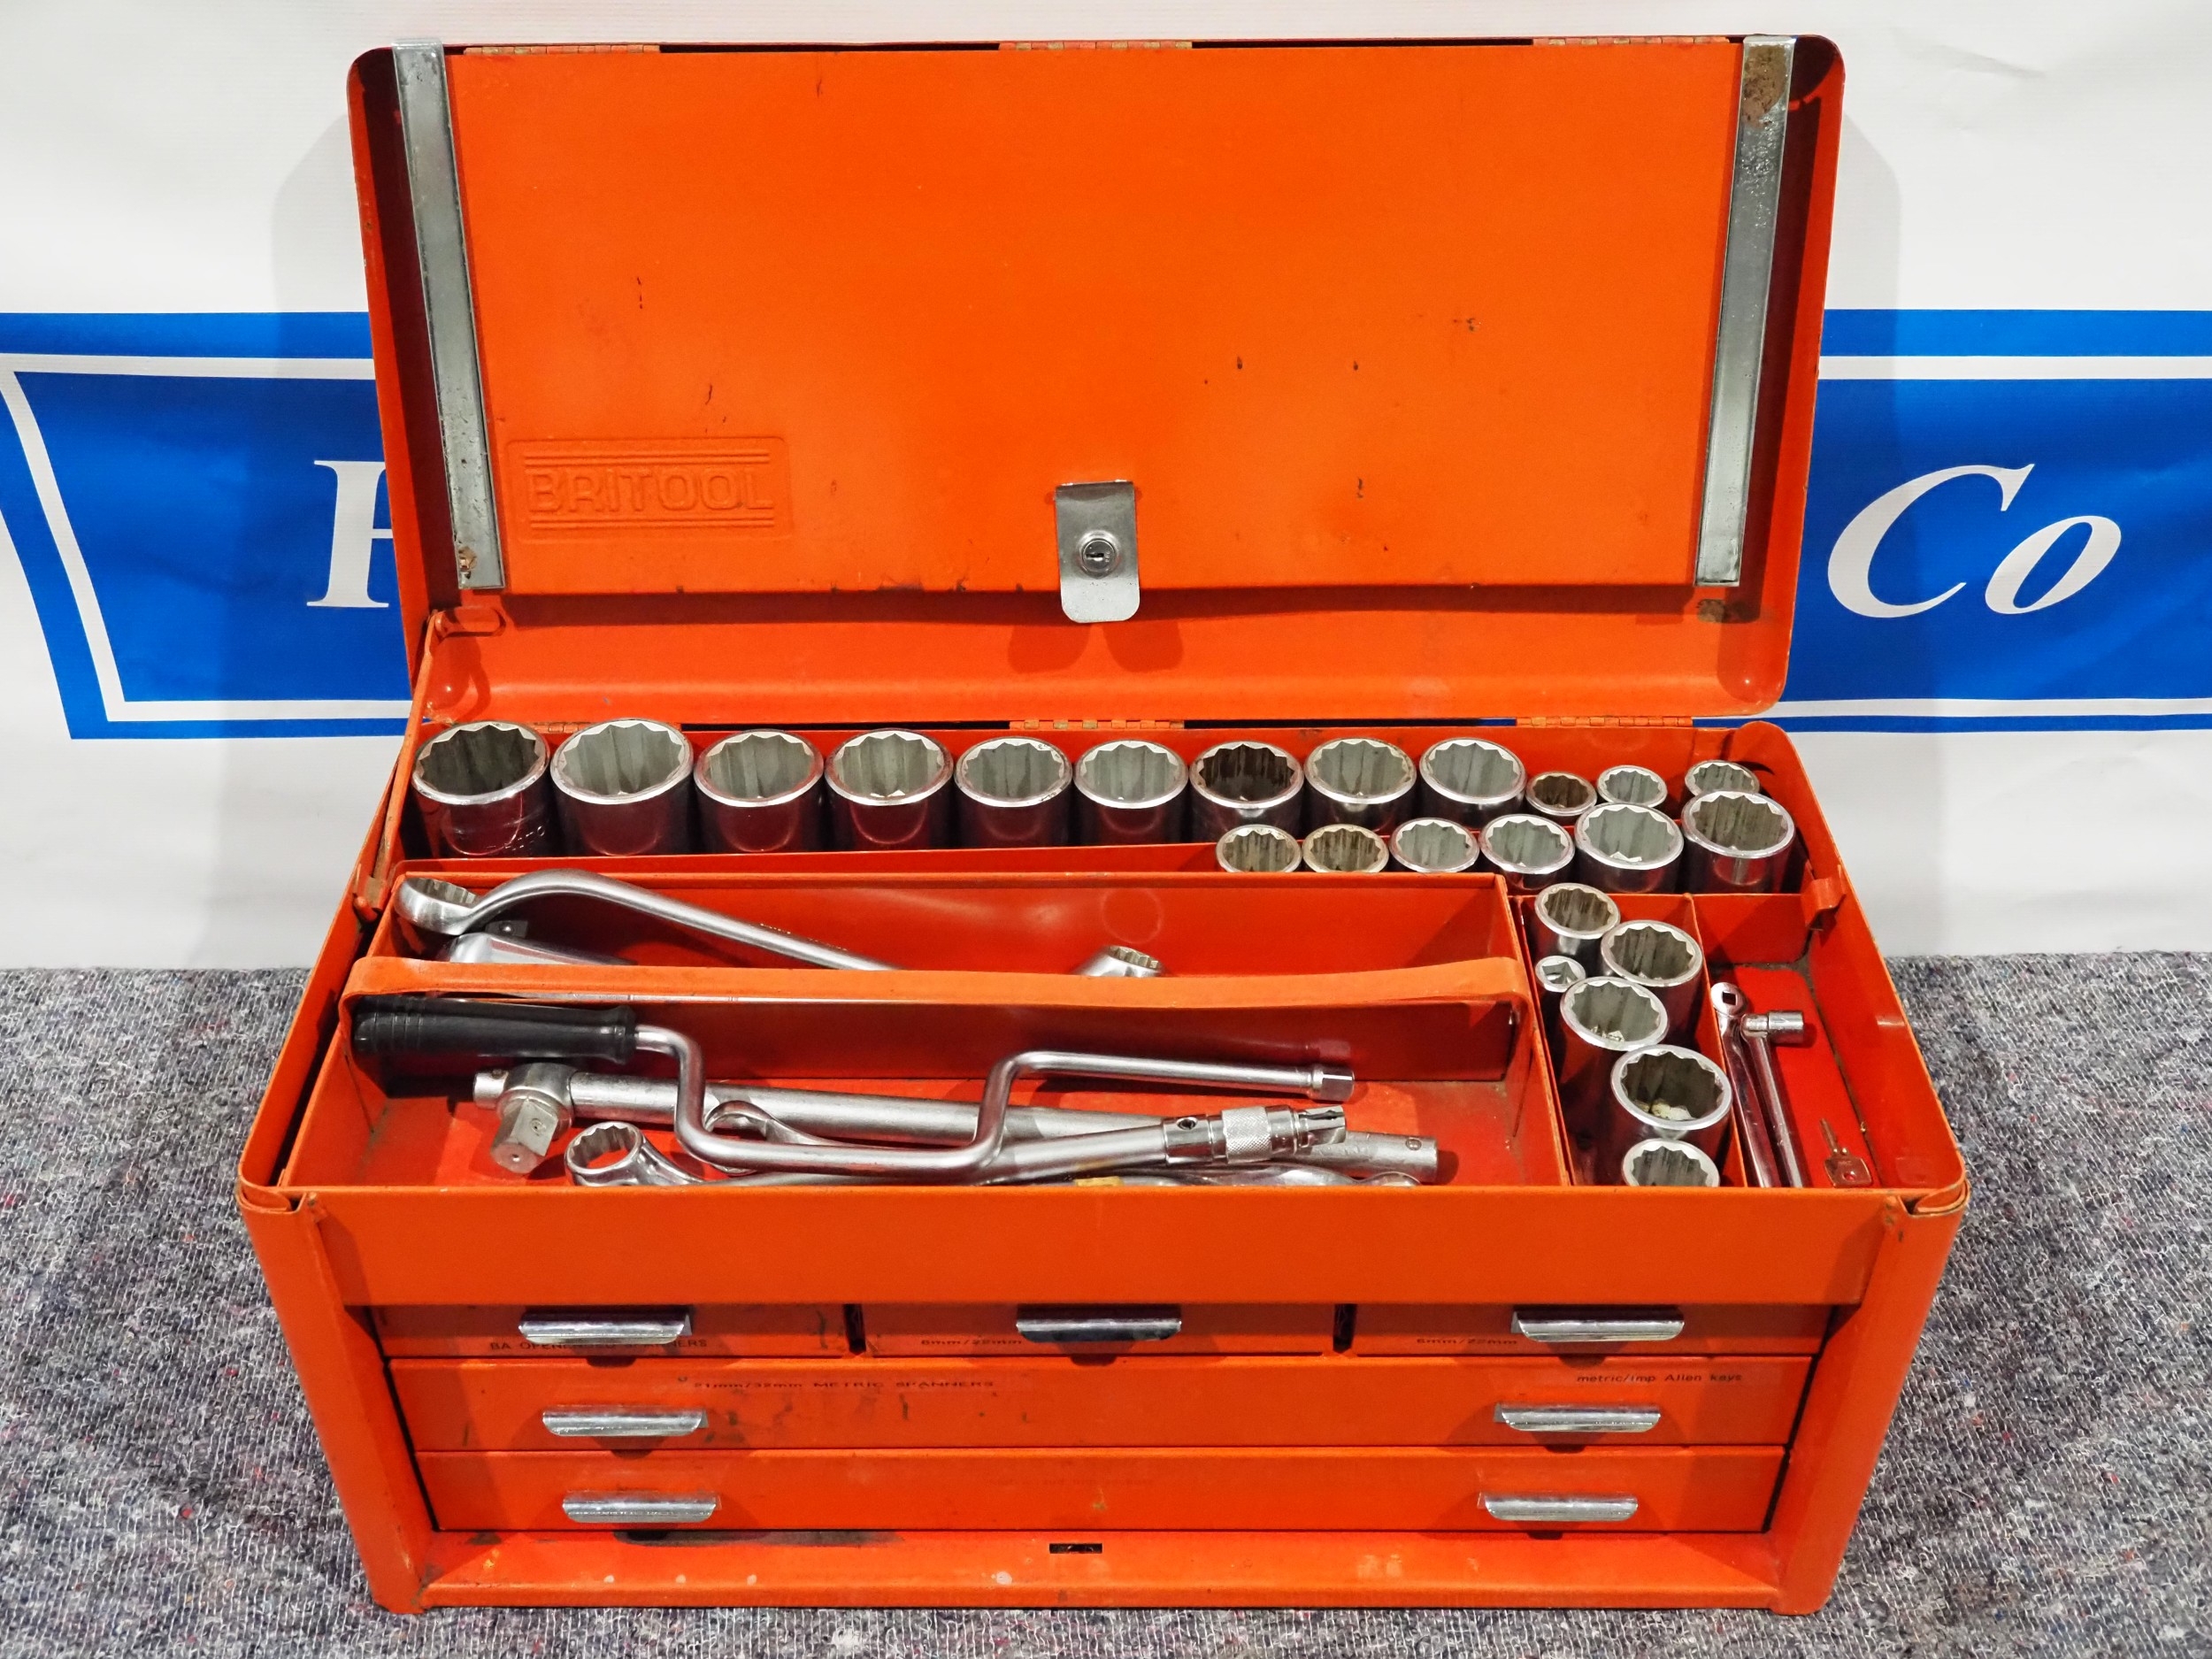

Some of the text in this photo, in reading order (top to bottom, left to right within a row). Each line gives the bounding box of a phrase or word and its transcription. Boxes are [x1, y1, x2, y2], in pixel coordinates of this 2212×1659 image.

[527, 468, 774, 513] BRITOOL
[1827, 463, 2122, 618] Co
[489, 1341, 511, 1350] BA
